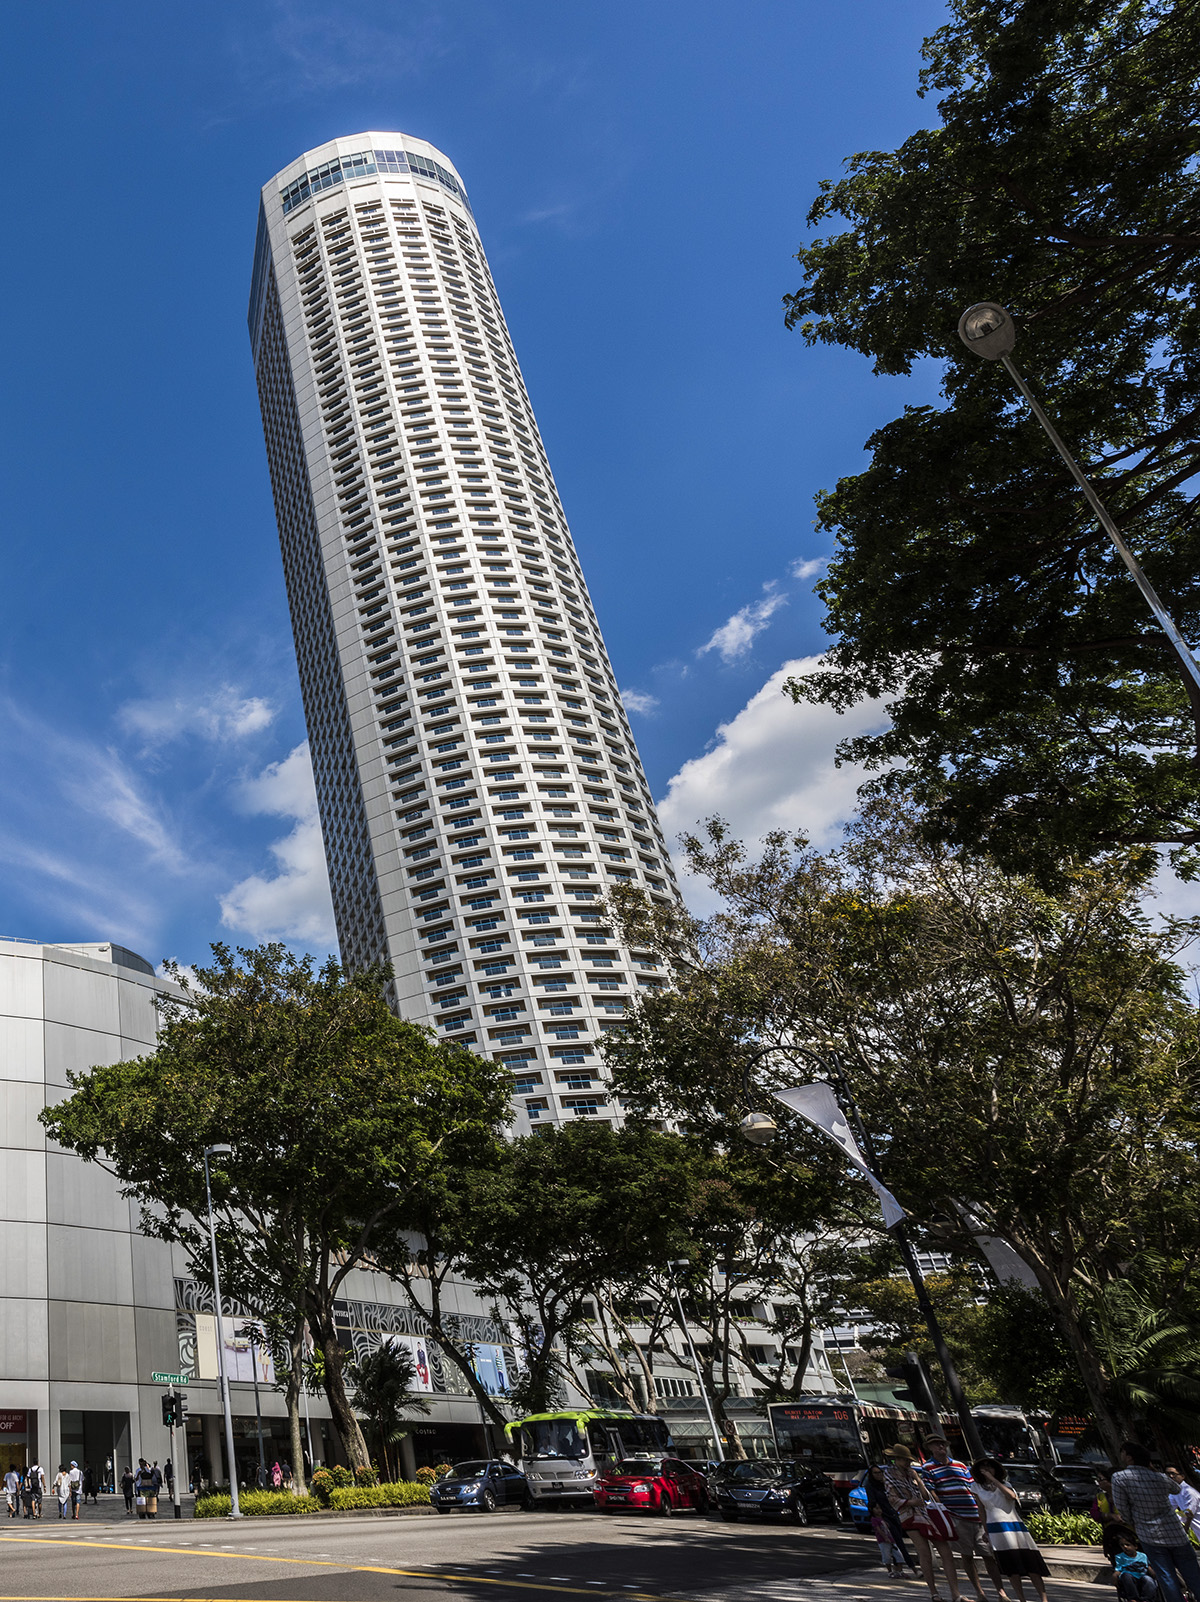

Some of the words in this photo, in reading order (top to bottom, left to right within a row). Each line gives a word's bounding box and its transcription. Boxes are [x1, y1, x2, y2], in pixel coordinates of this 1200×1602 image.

[155, 1373, 179, 1383] Stamford
[180, 1375, 187, 1384] Rd
[833, 1410, 849, 1420] 106
